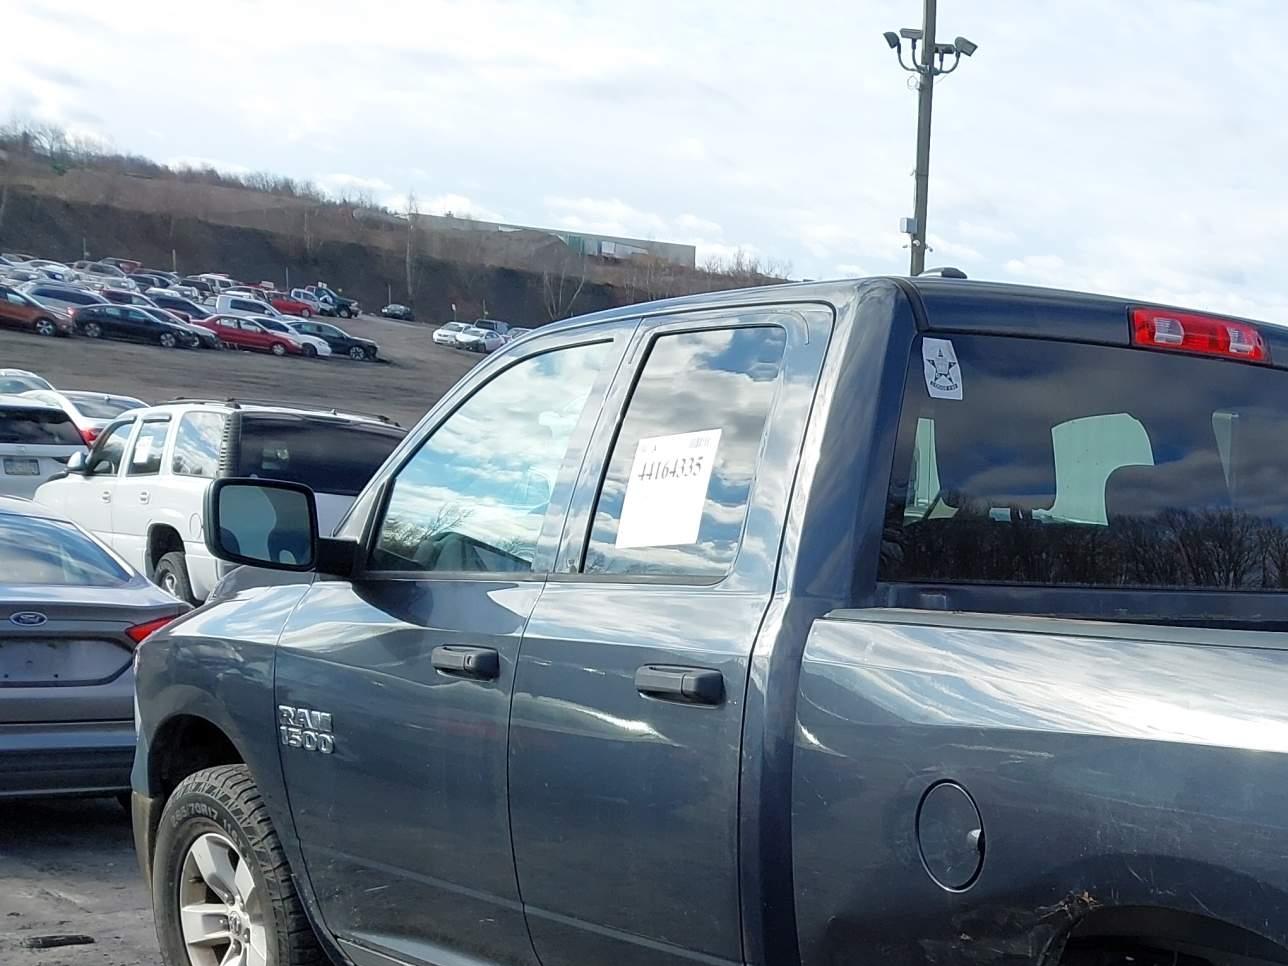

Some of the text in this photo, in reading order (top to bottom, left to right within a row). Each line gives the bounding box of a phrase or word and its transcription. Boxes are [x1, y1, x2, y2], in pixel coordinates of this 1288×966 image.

[637, 455, 703, 480] 44164335
[278, 704, 332, 732] RAM
[279, 726, 335, 754] 1500
